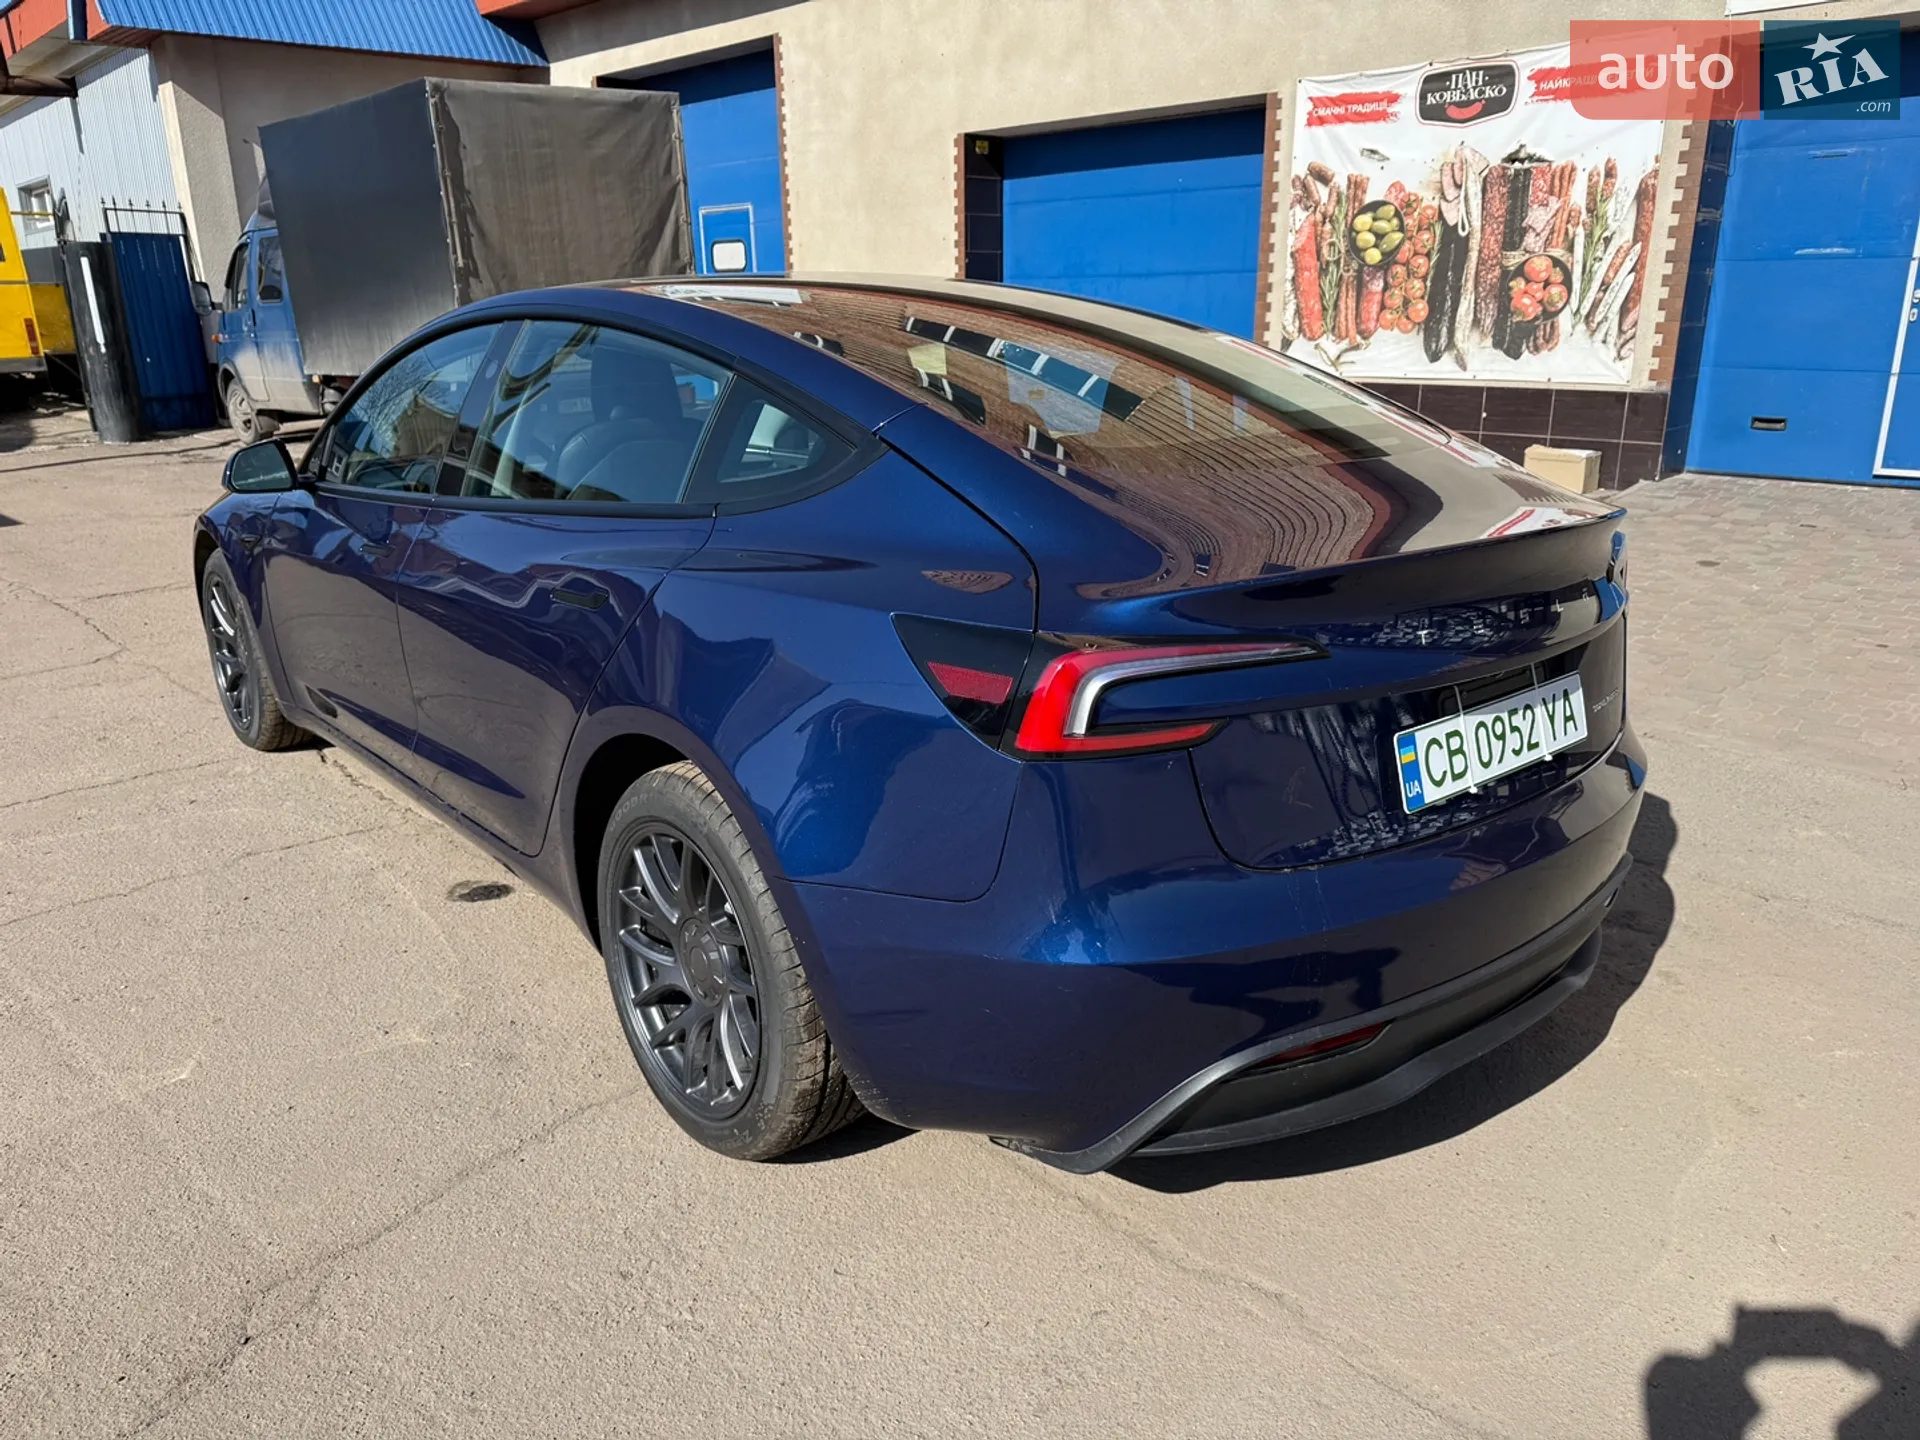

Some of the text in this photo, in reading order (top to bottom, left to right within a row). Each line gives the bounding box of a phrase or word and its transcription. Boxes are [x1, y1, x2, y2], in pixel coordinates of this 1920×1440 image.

[1451, 69, 1484, 89] ПАН
[1426, 84, 1507, 106] КОВБАСКО
[1312, 103, 1345, 117] СМАЧНІ
[1424, 729, 1469, 788] CB
[1474, 703, 1540, 769] 0952
[1541, 688, 1578, 742] YA
[1405, 780, 1421, 798] UA
